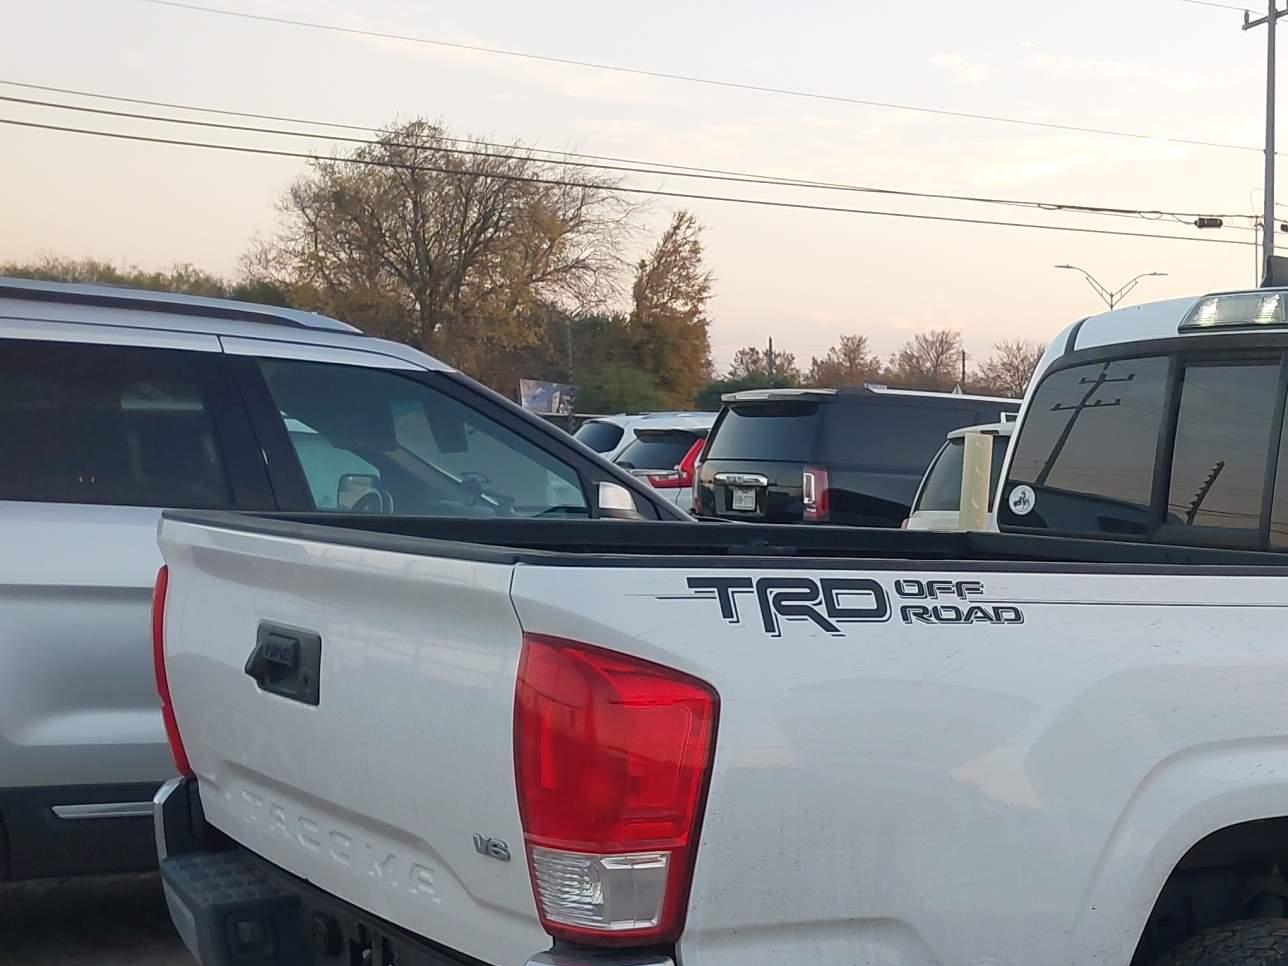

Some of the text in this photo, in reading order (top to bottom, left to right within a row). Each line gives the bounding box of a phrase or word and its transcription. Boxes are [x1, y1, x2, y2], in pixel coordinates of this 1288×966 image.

[686, 577, 984, 637] TRD OFF
[900, 604, 1025, 625] ROAD
[472, 832, 511, 861] V6
